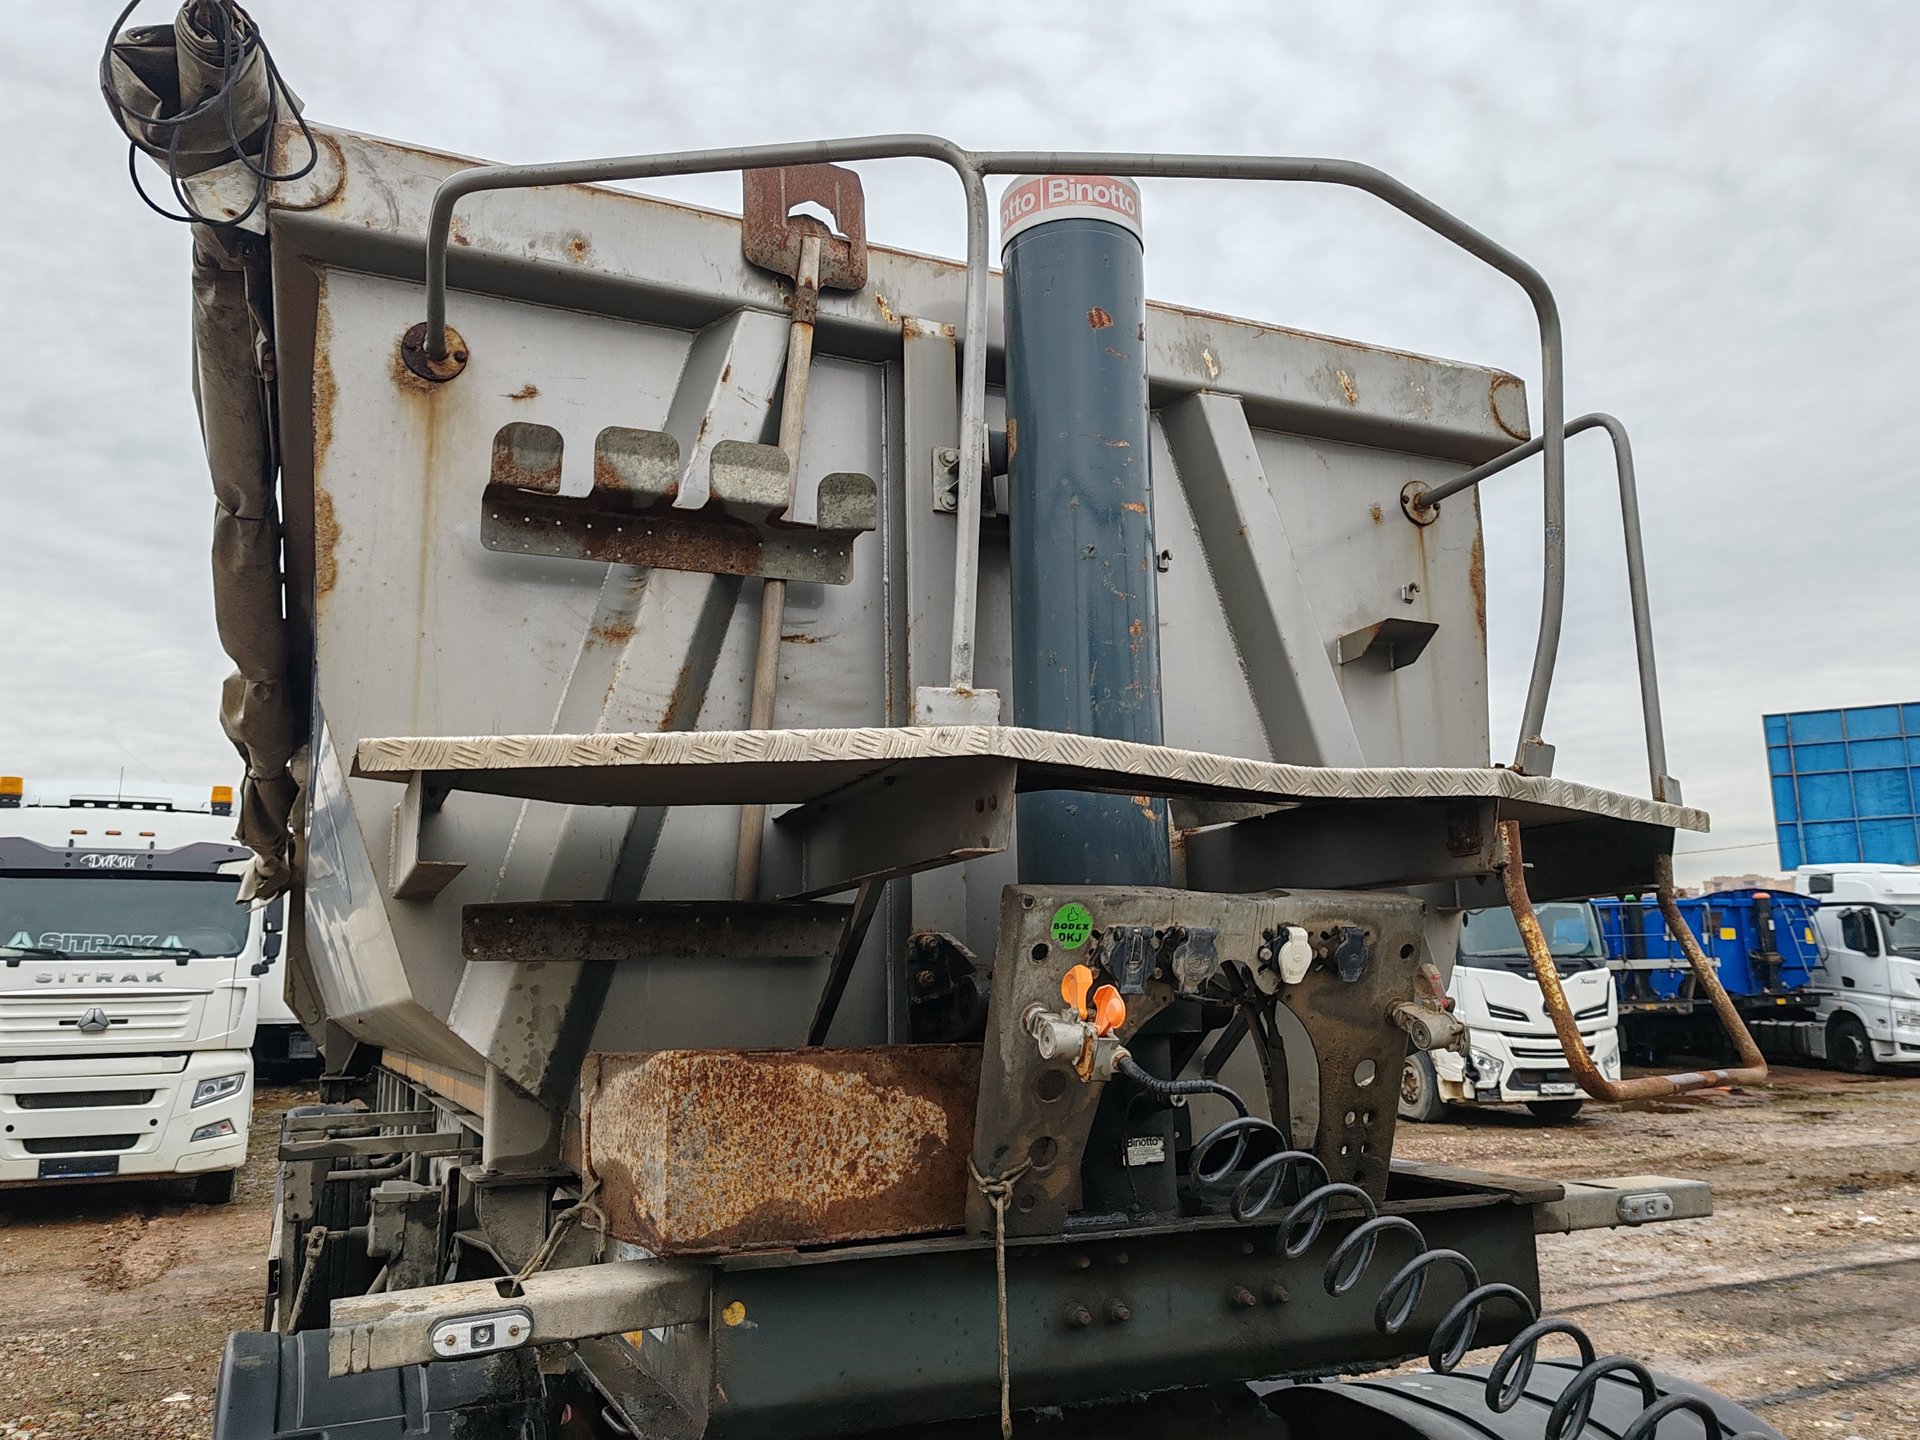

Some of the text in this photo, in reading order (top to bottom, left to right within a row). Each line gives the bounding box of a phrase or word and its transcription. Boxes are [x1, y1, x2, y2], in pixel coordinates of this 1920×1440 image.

[1047, 177, 1136, 217] Binotto
[1053, 922, 1090, 931] BODEX
[38, 931, 158, 954] SITRAK
[1058, 932, 1083, 943] DKJ
[34, 969, 166, 984] SITRAK
[1126, 1136, 1159, 1148] Binotto
